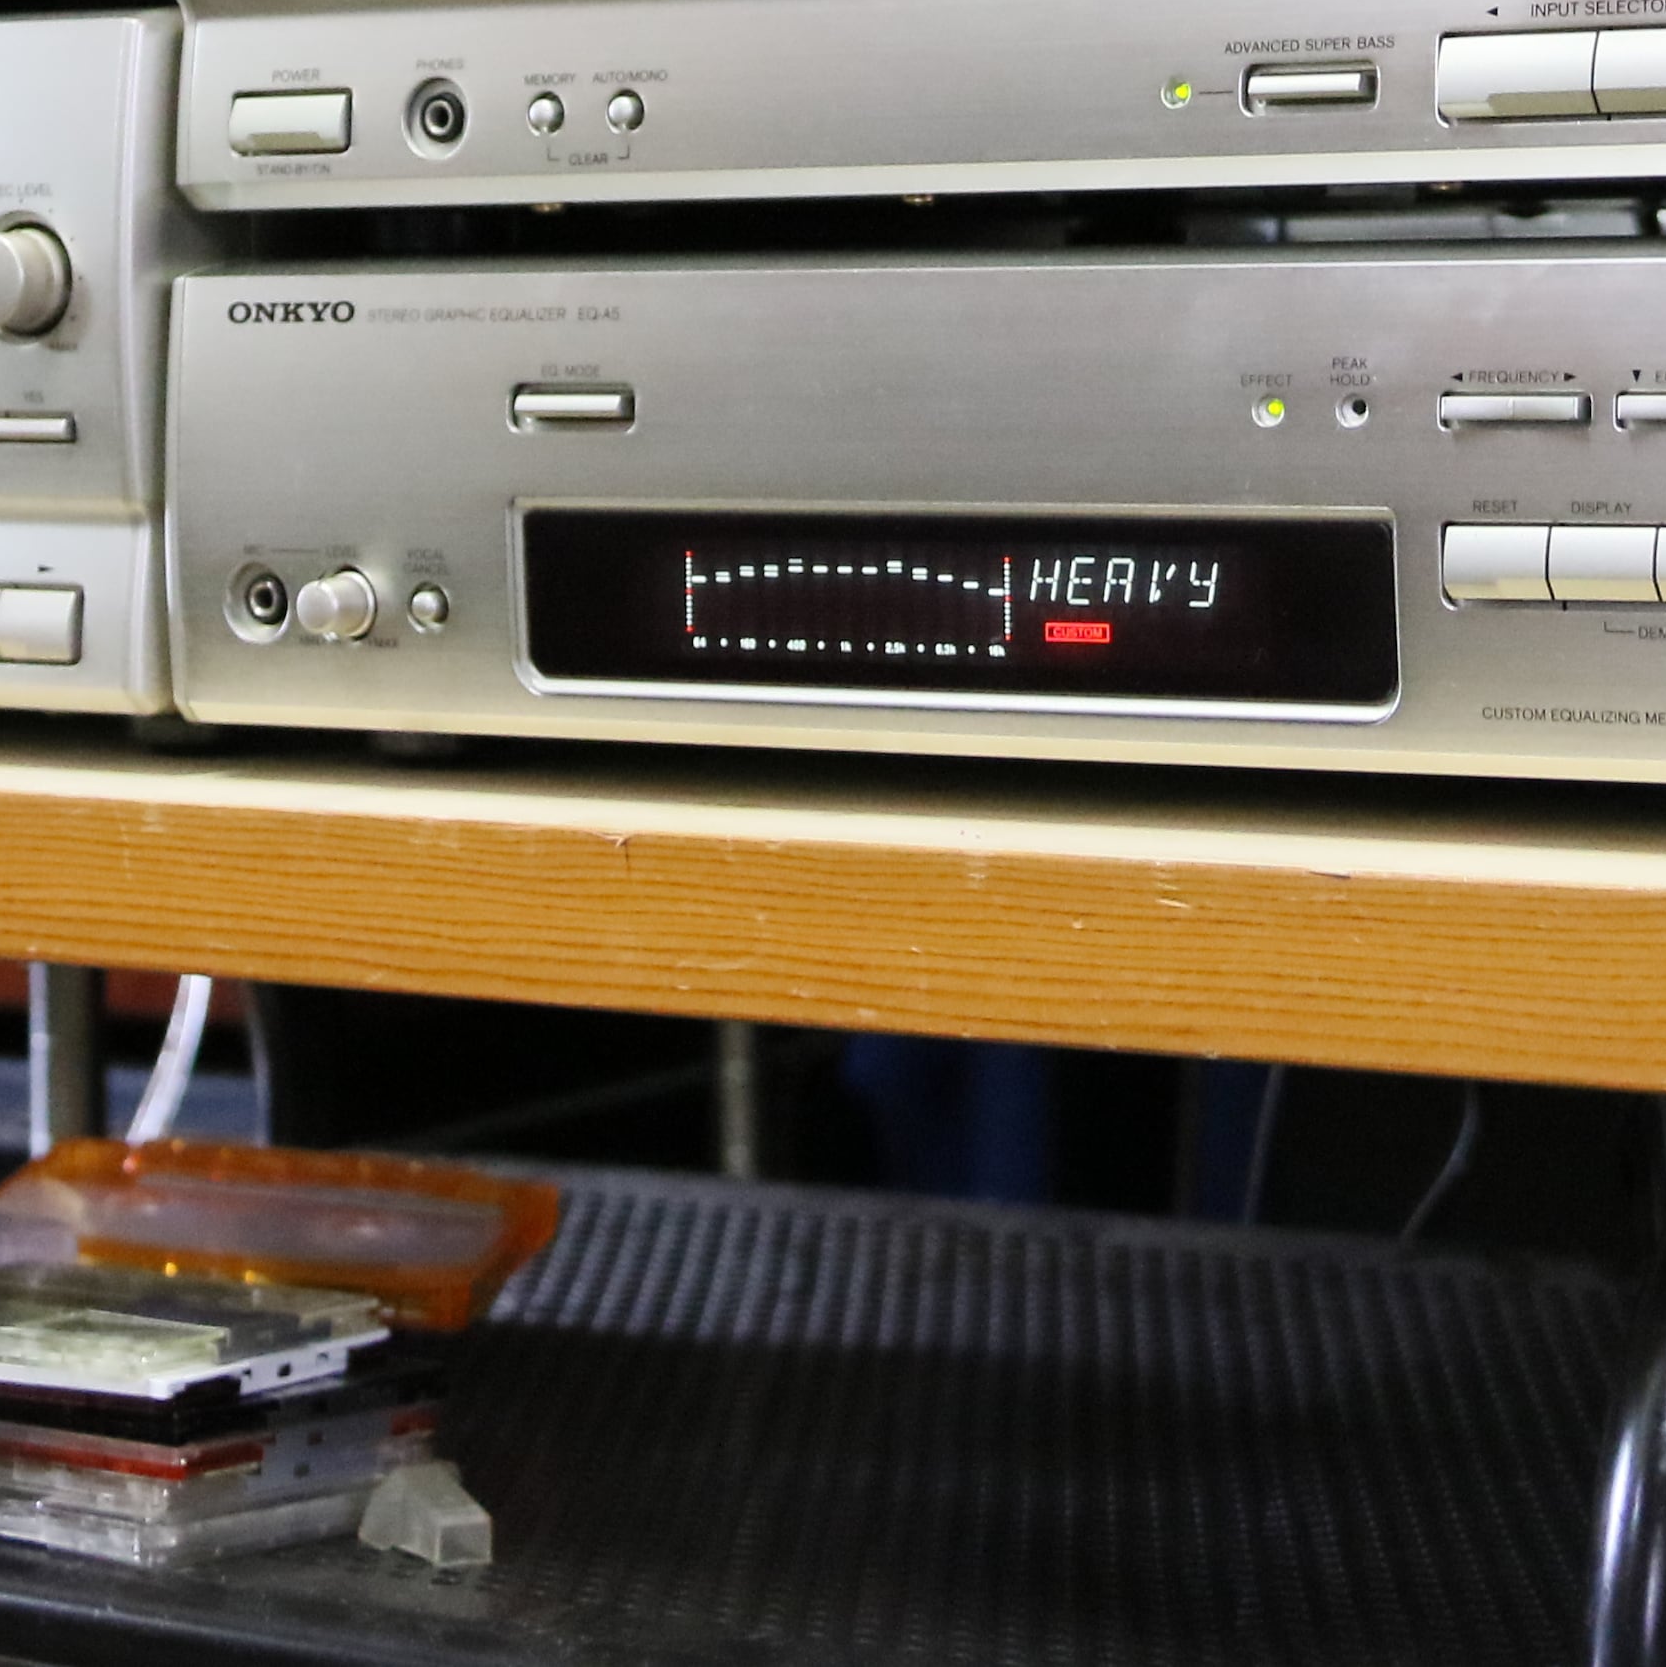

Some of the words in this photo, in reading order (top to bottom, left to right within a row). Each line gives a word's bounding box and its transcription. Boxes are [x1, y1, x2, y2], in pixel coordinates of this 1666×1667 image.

[1530, 1, 1579, 18] INPUT
[1224, 38, 1300, 55] ADVANCED
[1304, 36, 1351, 52] SUPER
[1357, 34, 1395, 50] BASS
[415, 58, 465, 71] PHONES
[271, 69, 321, 83] POWER
[523, 73, 576, 85] MEMORY
[592, 69, 668, 83] AUTO/MONO
[568, 152, 609, 166] CLEAR
[227, 299, 356, 325] ONKYO
[489, 307, 567, 322] EQUALIZER
[1332, 356, 1368, 371] PEAK
[1240, 374, 1293, 387] EFFECT
[1329, 373, 1371, 386] HOLD
[1468, 369, 1559, 383] FREQUENCY
[1472, 500, 1518, 514] RESET
[1571, 501, 1633, 515] DISPLAY
[1029, 556, 1220, 609] HEAVY
[1052, 627, 1104, 639] CUSTOM
[1482, 706, 1546, 721] CUSTOM
[1550, 708, 1641, 724] EQUALIZING
